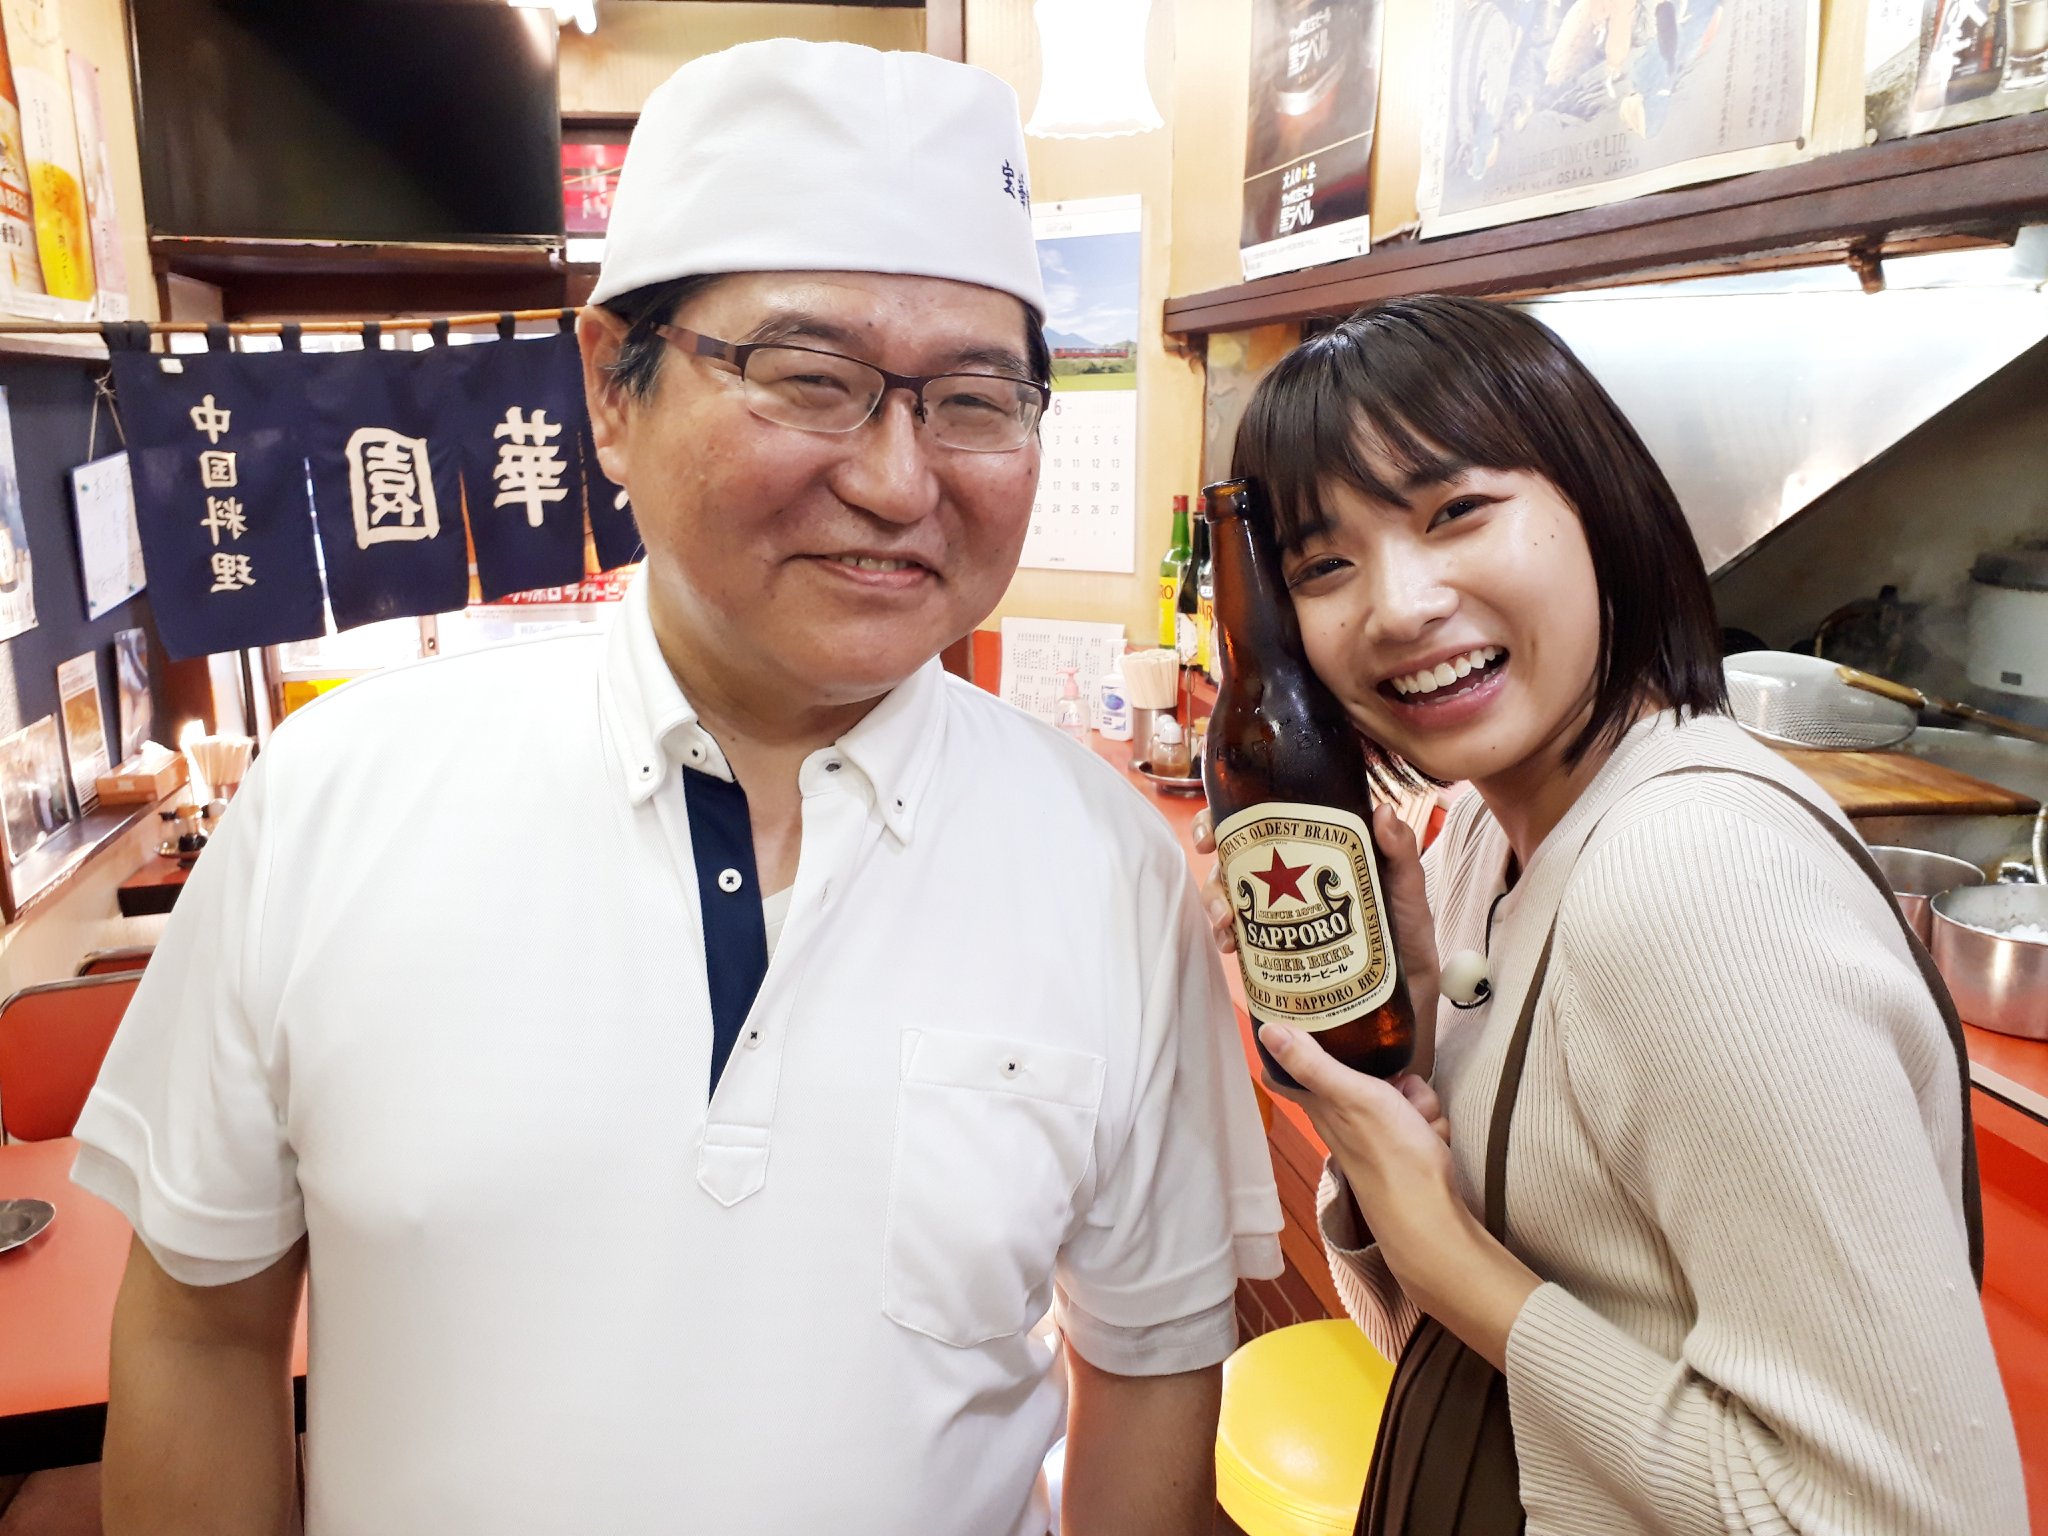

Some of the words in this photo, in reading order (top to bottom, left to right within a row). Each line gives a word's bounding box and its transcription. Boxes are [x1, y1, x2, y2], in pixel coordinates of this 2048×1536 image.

[1054, 399, 1062, 416] 6
[1249, 821, 1300, 841] OLDEST
[1304, 825, 1348, 846] BRAND
[1247, 912, 1347, 950] SAPPORO
[1275, 996, 1289, 1010] BY
[1295, 986, 1353, 1010] SAPPORO
[1354, 855, 1377, 911] LIMITED
[1254, 953, 1305, 971] LAGER
[1306, 943, 1354, 970] BEER
[1262, 963, 1348, 983] サッポロラガービール
